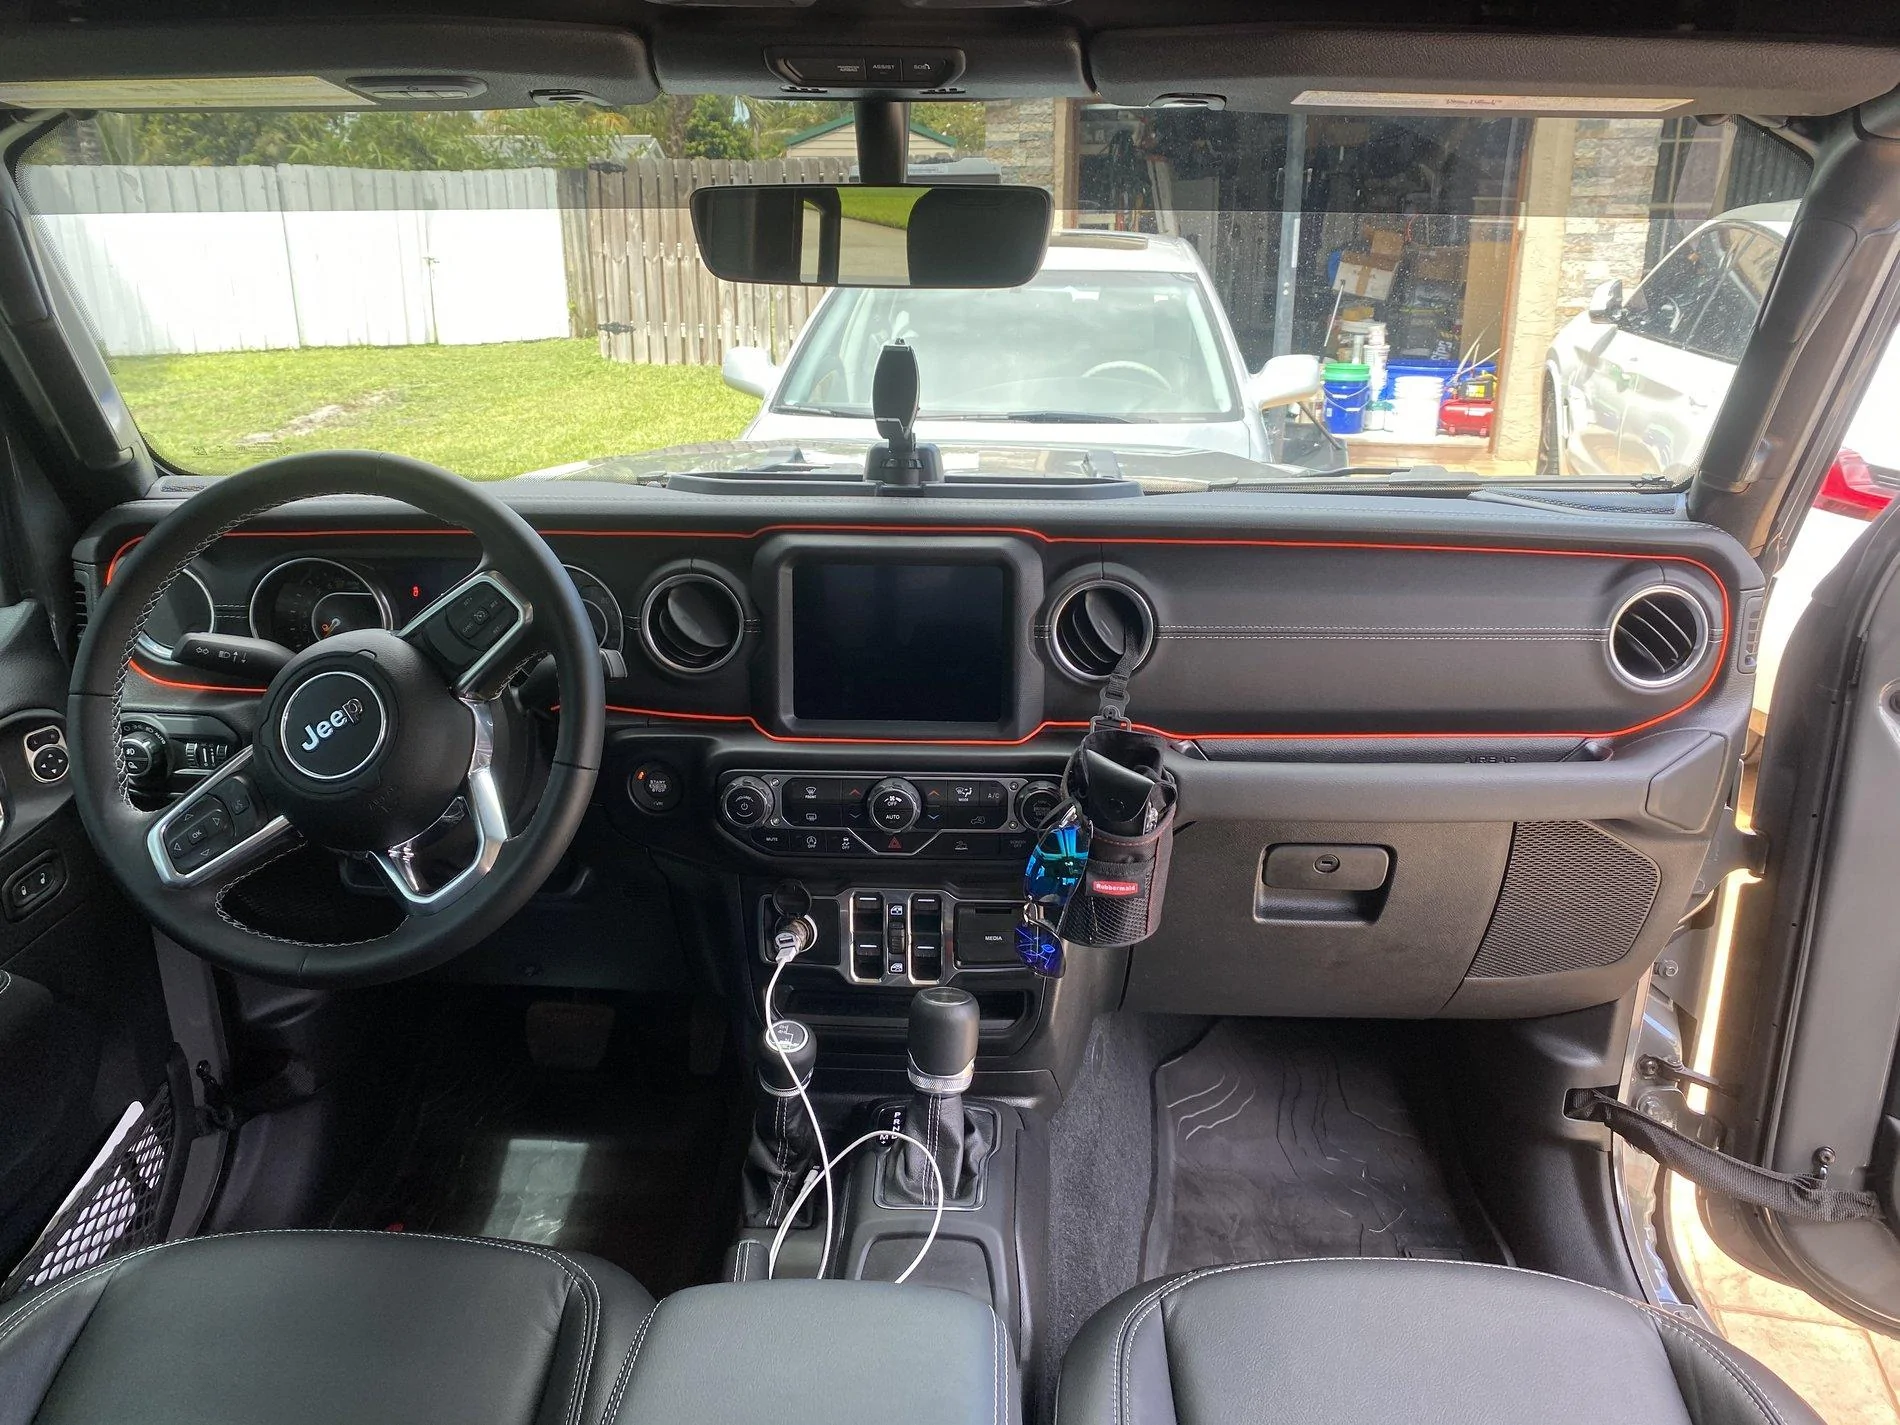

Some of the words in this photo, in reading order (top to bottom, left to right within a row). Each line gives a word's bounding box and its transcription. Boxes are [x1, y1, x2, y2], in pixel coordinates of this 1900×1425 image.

[301, 698, 363, 751] Jeep
[153, 732, 165, 745] AUTO
[192, 829, 202, 838] OK
[1096, 883, 1136, 892] Rubbermaid
